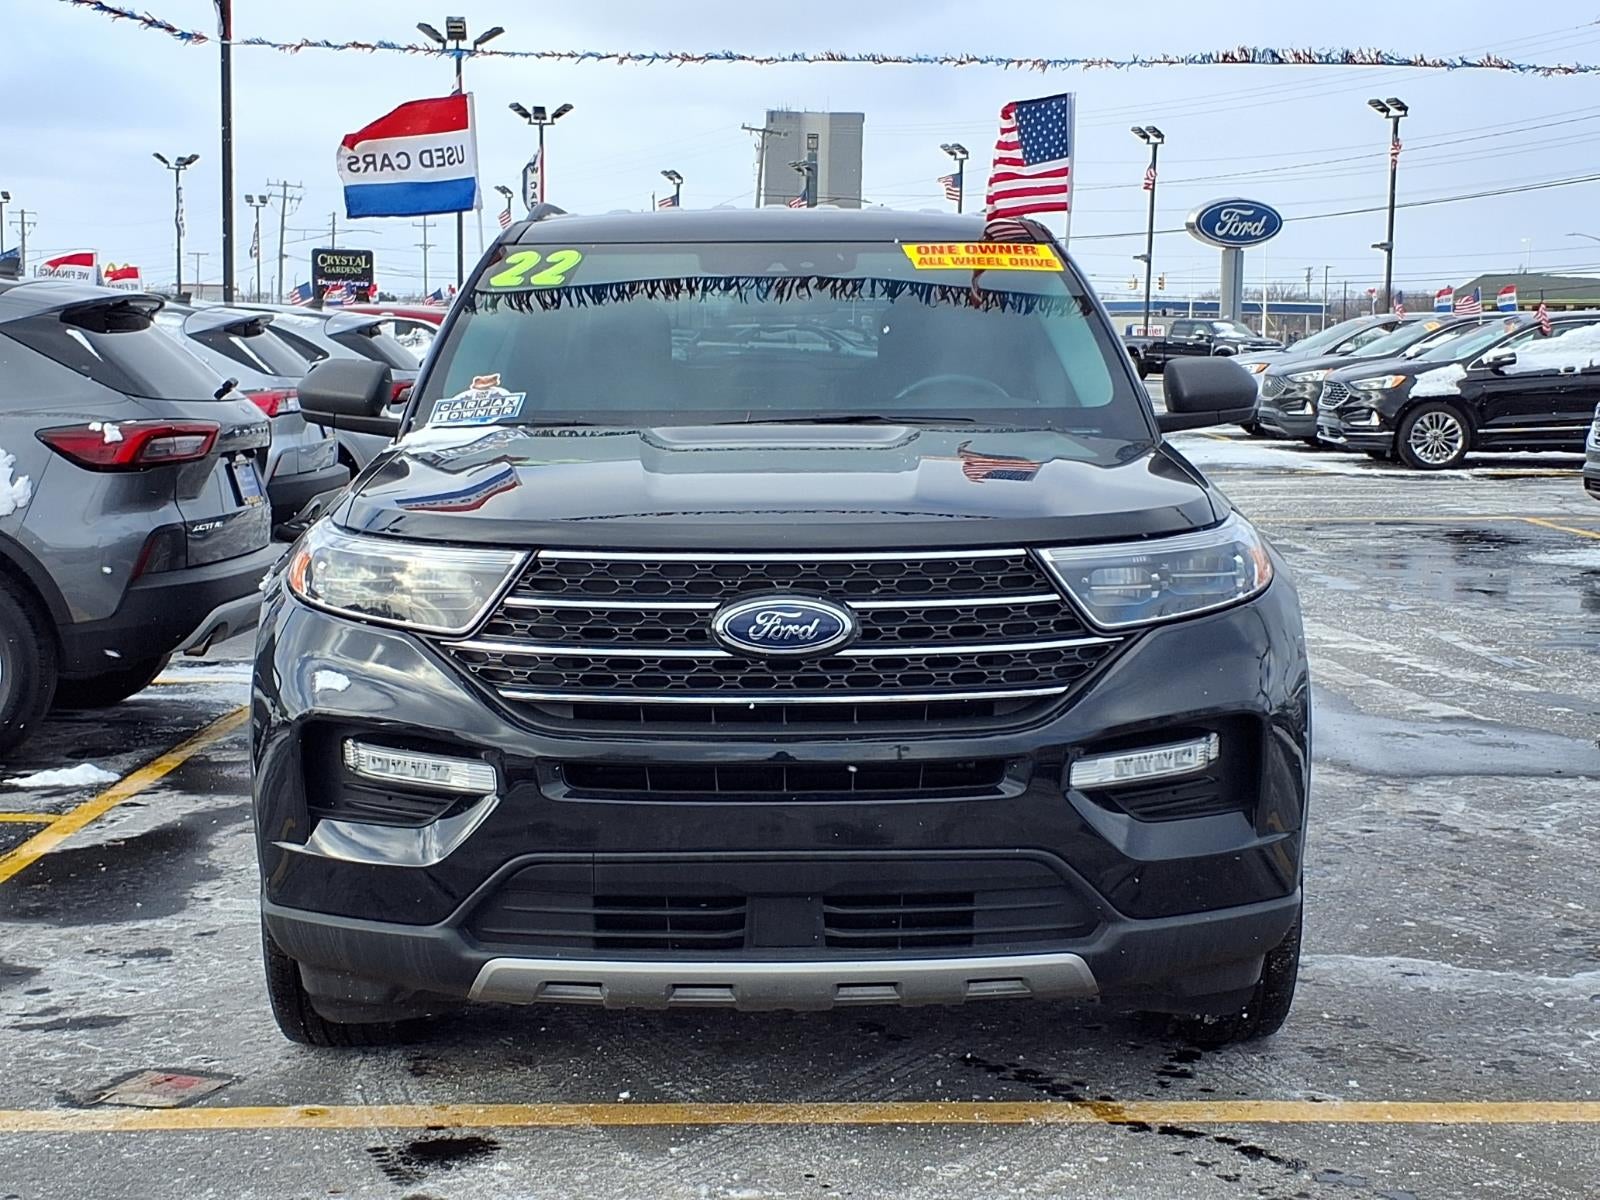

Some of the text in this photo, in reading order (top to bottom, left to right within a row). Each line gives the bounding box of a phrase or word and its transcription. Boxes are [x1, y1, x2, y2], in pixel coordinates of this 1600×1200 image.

[1215, 208, 1267, 236] Ford
[916, 244, 1038, 256] ONE OWNER
[317, 253, 370, 269] CRYSTAL
[489, 249, 582, 287] 22
[917, 256, 1057, 268] ALL WHEEL DRIVE
[324, 265, 362, 274] GARDENS
[1136, 325, 1162, 336] mijer
[439, 397, 516, 411] CARFAX
[449, 406, 513, 420] OWNER
[748, 610, 821, 640] Ford
